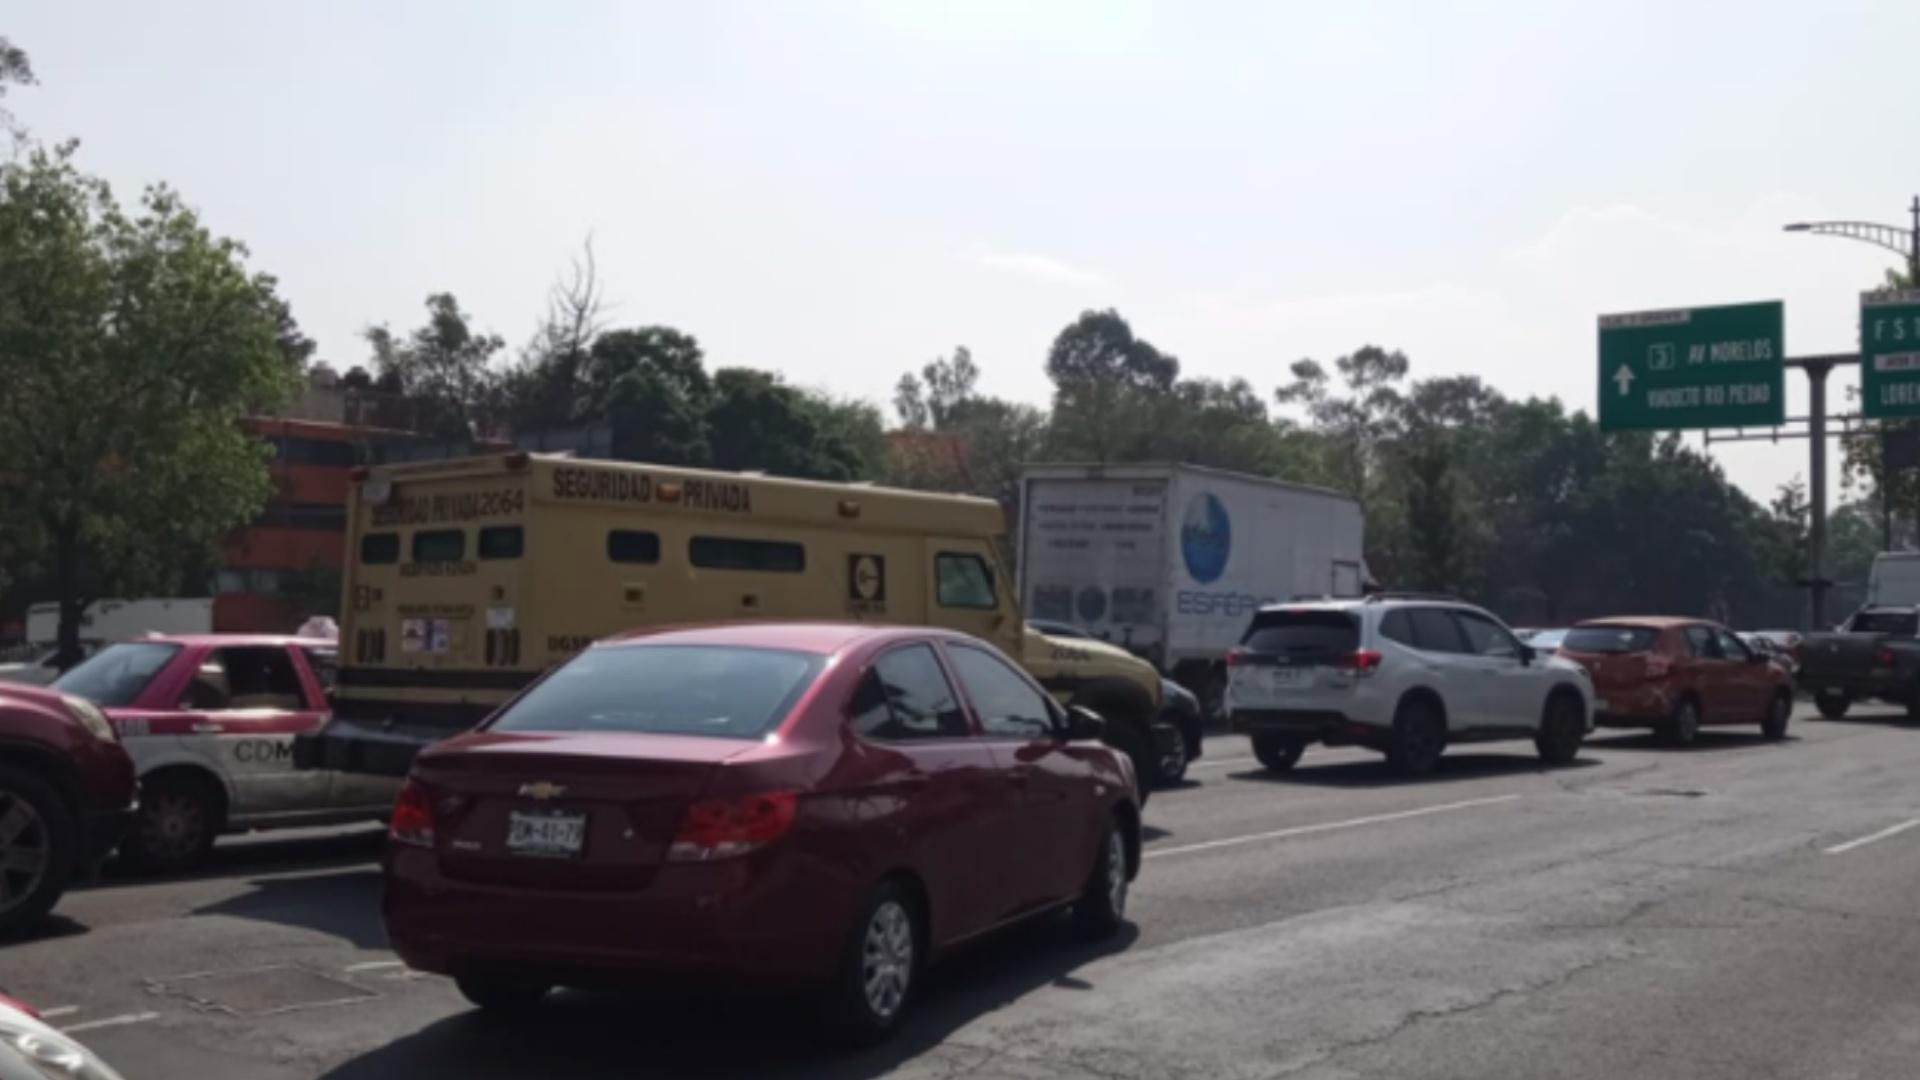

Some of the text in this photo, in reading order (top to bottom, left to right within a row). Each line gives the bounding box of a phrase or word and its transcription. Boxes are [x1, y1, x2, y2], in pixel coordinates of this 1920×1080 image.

[1709, 337, 1773, 363] MORELOS
[1880, 381, 1920, 407] LORE
[432, 493, 478, 522] PRIVADA
[478, 488, 524, 516] 2064
[552, 467, 752, 513] SEGURIDAD PRIVADA
